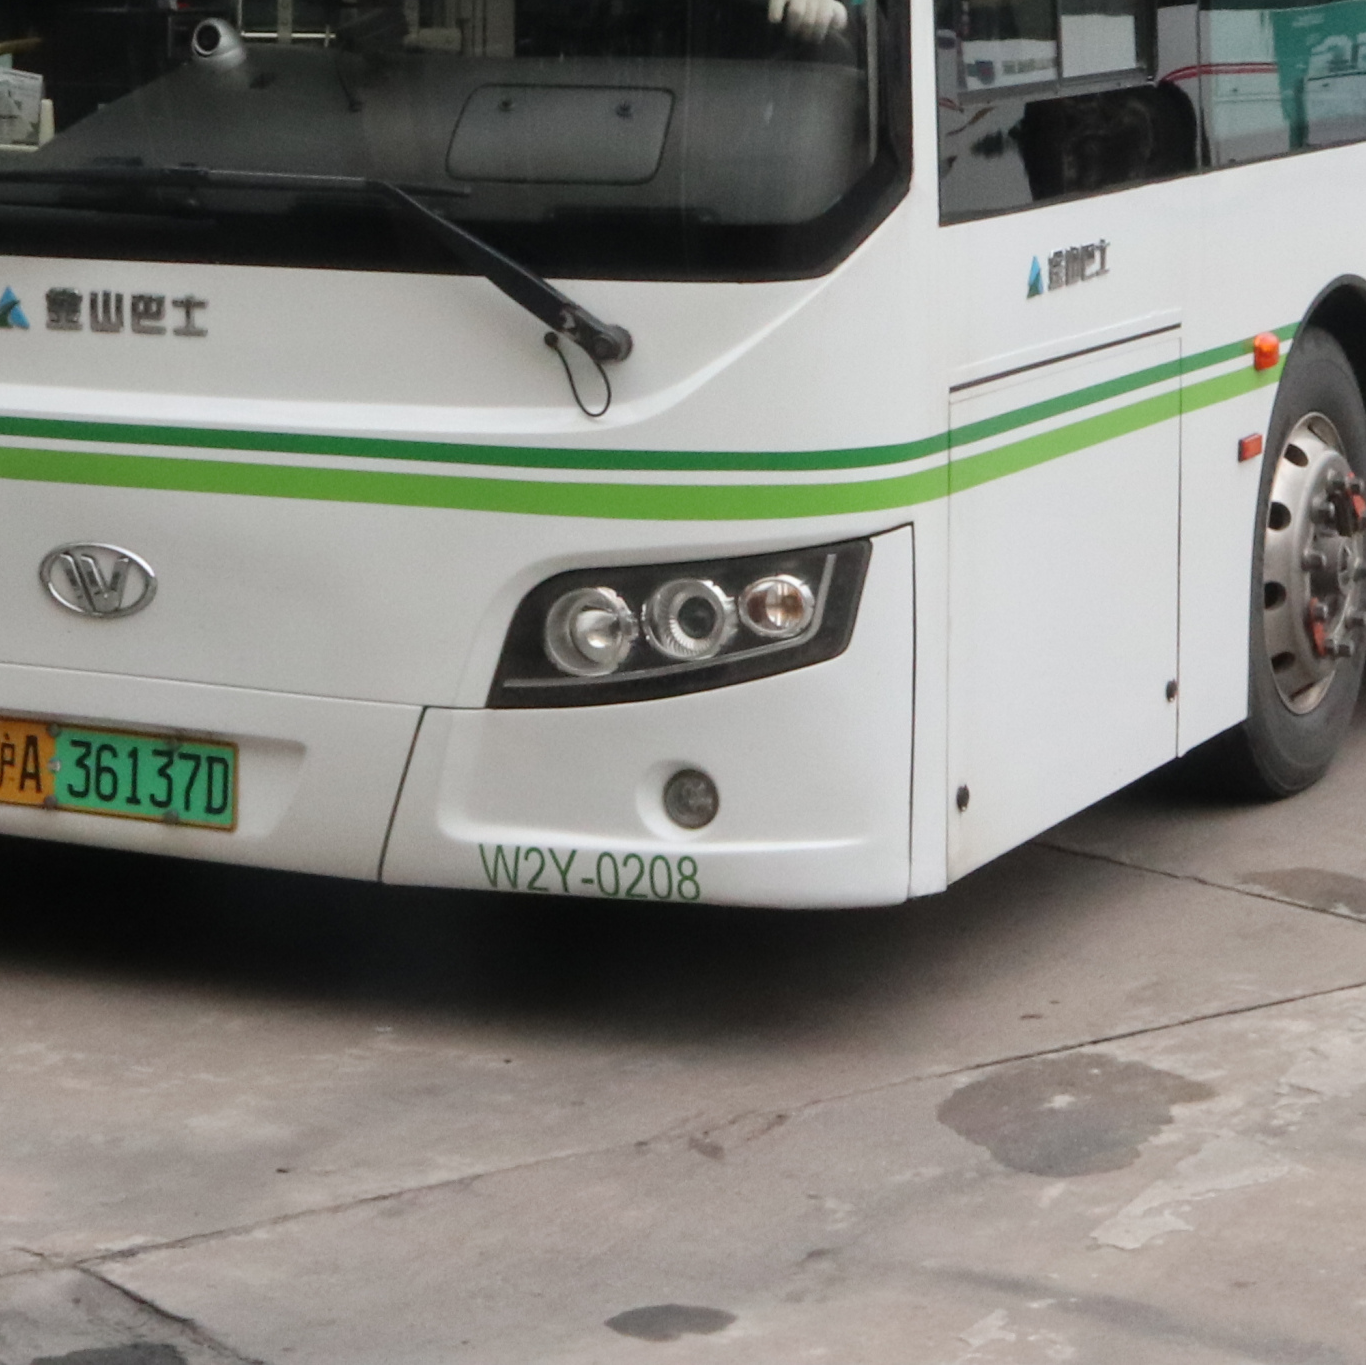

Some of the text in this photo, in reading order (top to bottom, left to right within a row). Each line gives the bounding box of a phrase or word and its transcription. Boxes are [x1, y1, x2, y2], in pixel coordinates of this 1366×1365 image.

[45, 287, 209, 337] 金山巴士
[67, 738, 229, 816] 36137D
[478, 843, 701, 902] W2Y-0208
